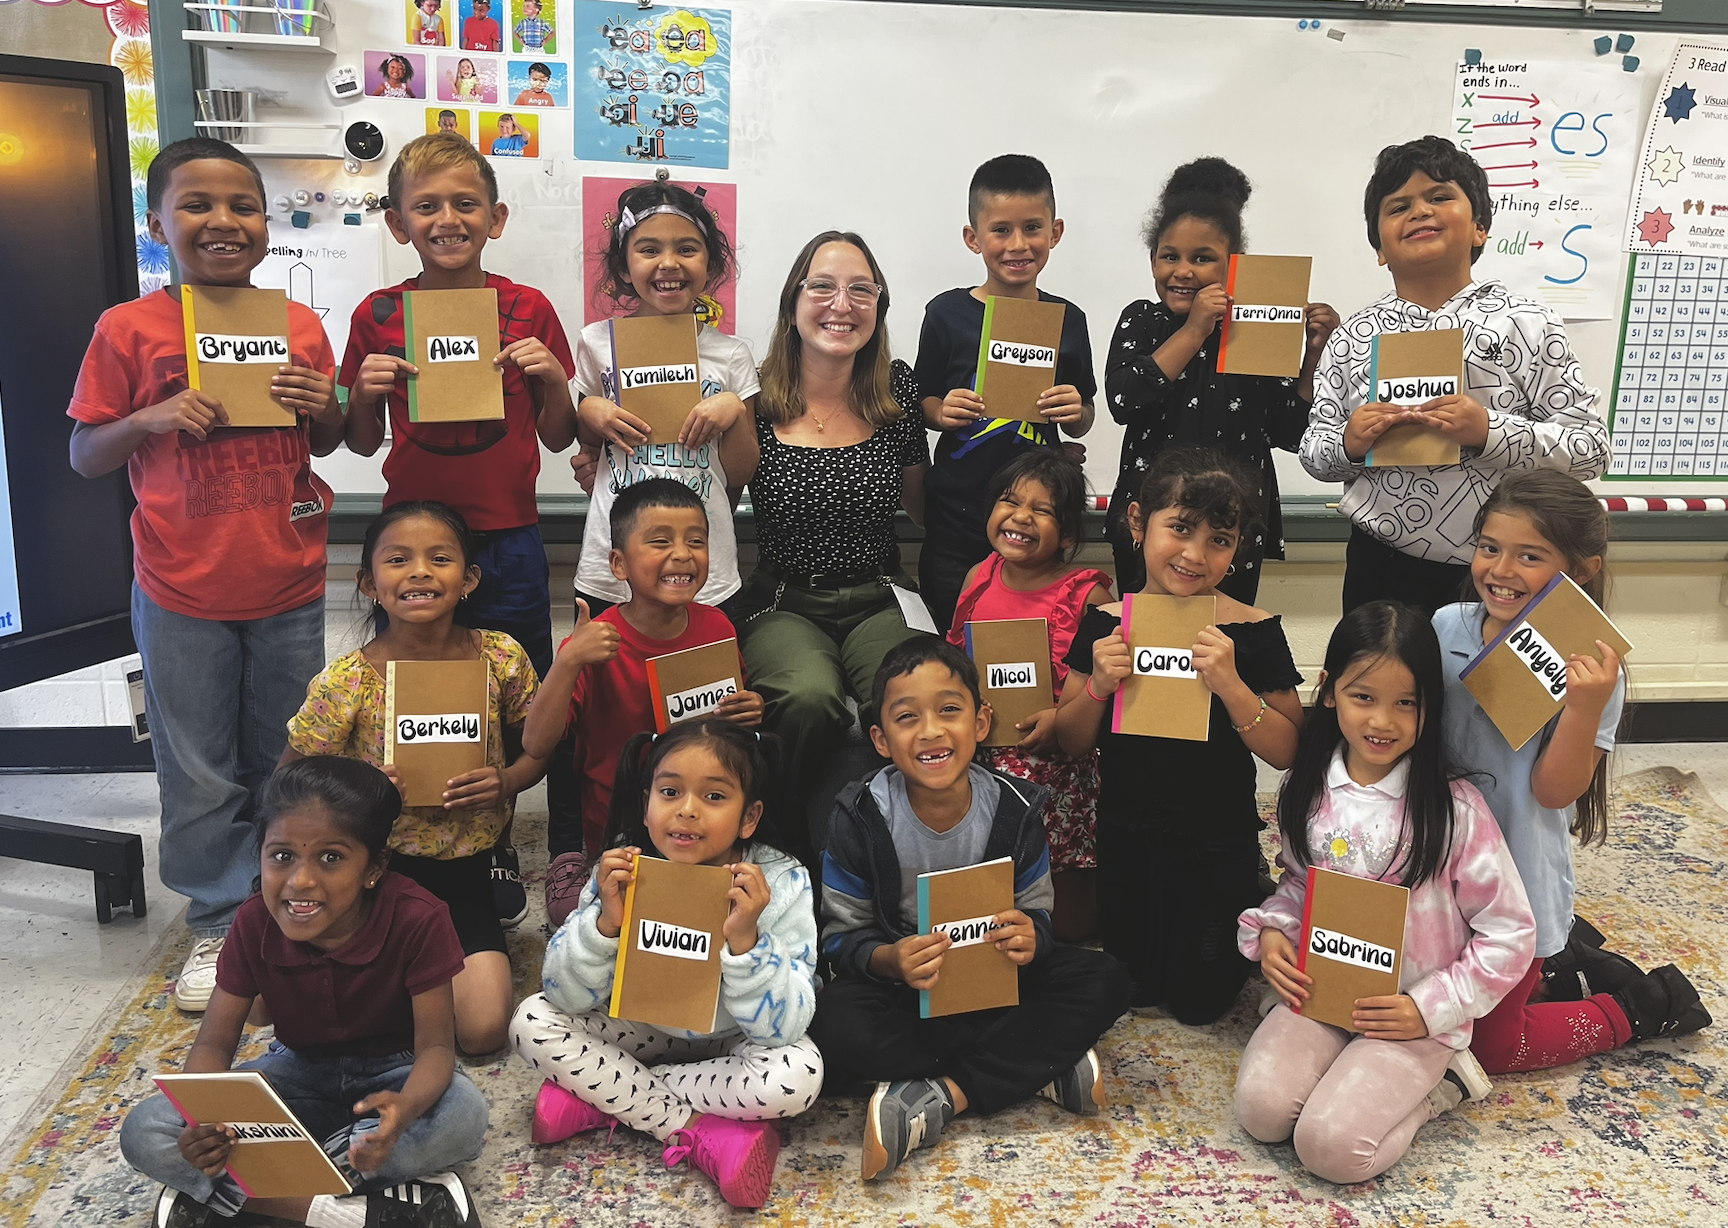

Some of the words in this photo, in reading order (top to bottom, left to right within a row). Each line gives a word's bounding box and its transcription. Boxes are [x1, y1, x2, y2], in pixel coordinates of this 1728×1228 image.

[422, 37, 436, 45] Sad
[474, 43, 488, 51] Shy
[1476, 62, 1495, 74] the
[1688, 57, 1697, 70] 3
[1697, 58, 1727, 73] Read
[1463, 76, 1490, 87] ends
[528, 97, 549, 106] Angry
[1492, 110, 1520, 124] add
[1550, 112, 1613, 157] es
[493, 147, 524, 156] Confused
[1662, 158, 1671, 173] 2
[1692, 155, 1726, 168] Identify
[1714, 173, 1727, 181] are
[1651, 219, 1661, 234] 3
[1688, 225, 1725, 237] Analyze
[1497, 231, 1530, 256] add
[1709, 242, 1722, 250] are
[322, 248, 348, 260] Tree
[1640, 261, 1650, 270] 21
[1661, 261, 1673, 271] 22
[1683, 262, 1695, 271] 23
[1705, 262, 1717, 271] 24
[1637, 284, 1647, 293] 31
[1658, 284, 1670, 293] 32
[1680, 284, 1692, 294] 33
[1701, 285, 1713, 294] 34
[1634, 306, 1644, 315] 41
[1655, 307, 1667, 315] 42
[1677, 307, 1689, 316] 43
[1631, 328, 1641, 337] 51
[1652, 329, 1664, 337] 52
[1674, 329, 1685, 338] 53
[1695, 329, 1707, 338] 54
[199, 336, 287, 362] Bryant
[430, 338, 476, 362] Alex
[991, 342, 1054, 364] Greyson
[1628, 351, 1638, 360] 61
[1649, 351, 1661, 360] 62
[1670, 351, 1682, 360] 63
[1692, 352, 1704, 360] 64
[1714, 352, 1725, 361] 65
[622, 366, 695, 388] Yamileth
[1626, 373, 1635, 381] 71
[1646, 373, 1657, 382] 72
[1668, 373, 1679, 382] 73
[1689, 373, 1700, 382] 74
[1711, 374, 1722, 383] 75
[1378, 378, 1455, 403] Joshua
[1622, 395, 1632, 403] 81
[1643, 395, 1654, 403] 82
[1664, 395, 1676, 404] 83
[1686, 395, 1698, 404] 84
[1708, 395, 1719, 404] 85
[1619, 416, 1628, 425] 91
[1640, 417, 1651, 425] 92
[1662, 417, 1673, 426] 93
[1683, 417, 1694, 425] 94
[1705, 417, 1716, 426] 95
[1615, 439, 1627, 447] 101
[1636, 439, 1650, 447] 102
[1657, 439, 1672, 447] 103
[1679, 439, 1693, 448] 104
[1700, 439, 1715, 448] 105
[632, 443, 710, 469] HELLO
[1613, 460, 1623, 468] 111
[1634, 460, 1646, 469] 112
[1655, 460, 1668, 469] 113
[1677, 461, 1690, 469] 114
[1698, 460, 1711, 469] 115
[185, 466, 295, 520] REEBOK
[291, 499, 324, 518] REEBOK
[1137, 649, 1195, 673] Caro
[1509, 627, 1567, 695] Anyely
[990, 666, 1031, 687] Nicol
[669, 685, 736, 718] James
[398, 716, 479, 741] Berkely
[641, 921, 708, 953] Vivian
[1311, 930, 1393, 968] Sabrina
